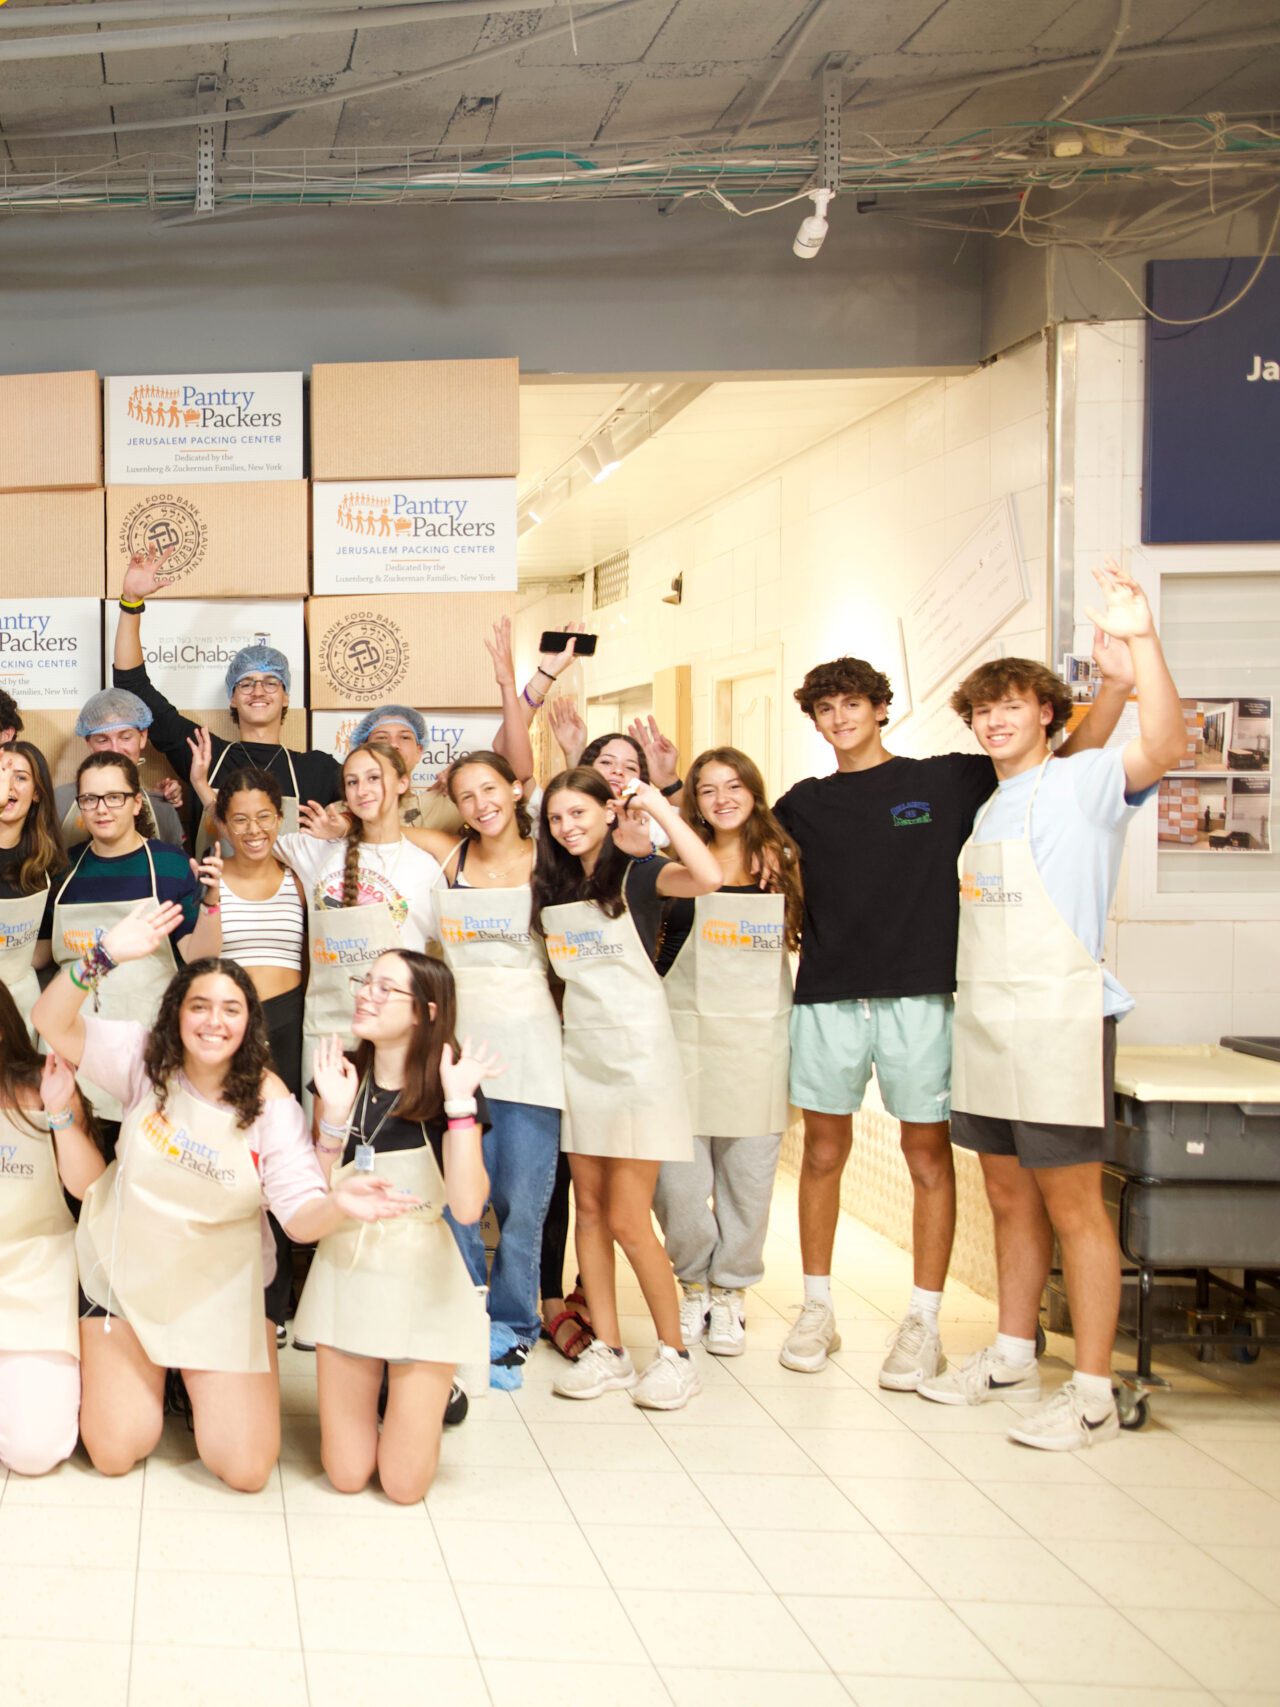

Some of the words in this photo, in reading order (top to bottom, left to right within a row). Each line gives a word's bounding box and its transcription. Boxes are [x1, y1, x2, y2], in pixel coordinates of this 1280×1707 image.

[182, 386, 255, 412] Pantry
[201, 406, 282, 428] Packers
[127, 437, 187, 446] JERUSALEM
[191, 436, 237, 445] PACKING
[241, 435, 282, 444] CENTER
[174, 454, 210, 462] Dedicated
[212, 454, 220, 462] by
[126, 465, 164, 474] Luxenberg
[172, 464, 213, 472] Zuckerman
[214, 464, 246, 472] Families,
[265, 463, 282, 472] York
[393, 494, 468, 521] Pantry
[119, 502, 143, 553] BLAVATNIK
[146, 494, 173, 504] FOOD
[176, 496, 200, 516] BANK
[412, 515, 495, 537] Packers
[336, 546, 397, 555] JERUSALEM
[402, 546, 449, 554] PACKING
[453, 546, 495, 554] CENTER
[385, 564, 422, 572] Dedicated
[424, 564, 432, 572] by
[336, 575, 374, 584] Luxenberg
[383, 574, 424, 582] Zuckerman
[426, 574, 458, 583] Families,
[461, 574, 477, 582] New
[479, 574, 496, 582] York
[318, 620, 343, 672] BLAVATNIK
[345, 612, 373, 621] FOOD
[376, 614, 401, 634] BANK
[181, 645, 248, 662] Chaba
[38, 660, 78, 668] CENTER
[8, 678, 17, 686] by
[12, 688, 43, 696] Families,
[62, 688, 78, 696] York
[327, 680, 352, 700] BANK
[355, 693, 384, 702] FOOD
[431, 726, 465, 748] try
[422, 744, 468, 764] acke
[412, 772, 438, 781] CKIN
[464, 916, 512, 930] Pantry
[478, 930, 530, 942] Packers
[566, 929, 603, 946] Pantry
[752, 935, 784, 948] Pack
[326, 937, 368, 951] Pantry
[576, 940, 623, 958] Packers
[180, 1150, 236, 1181] Packers
